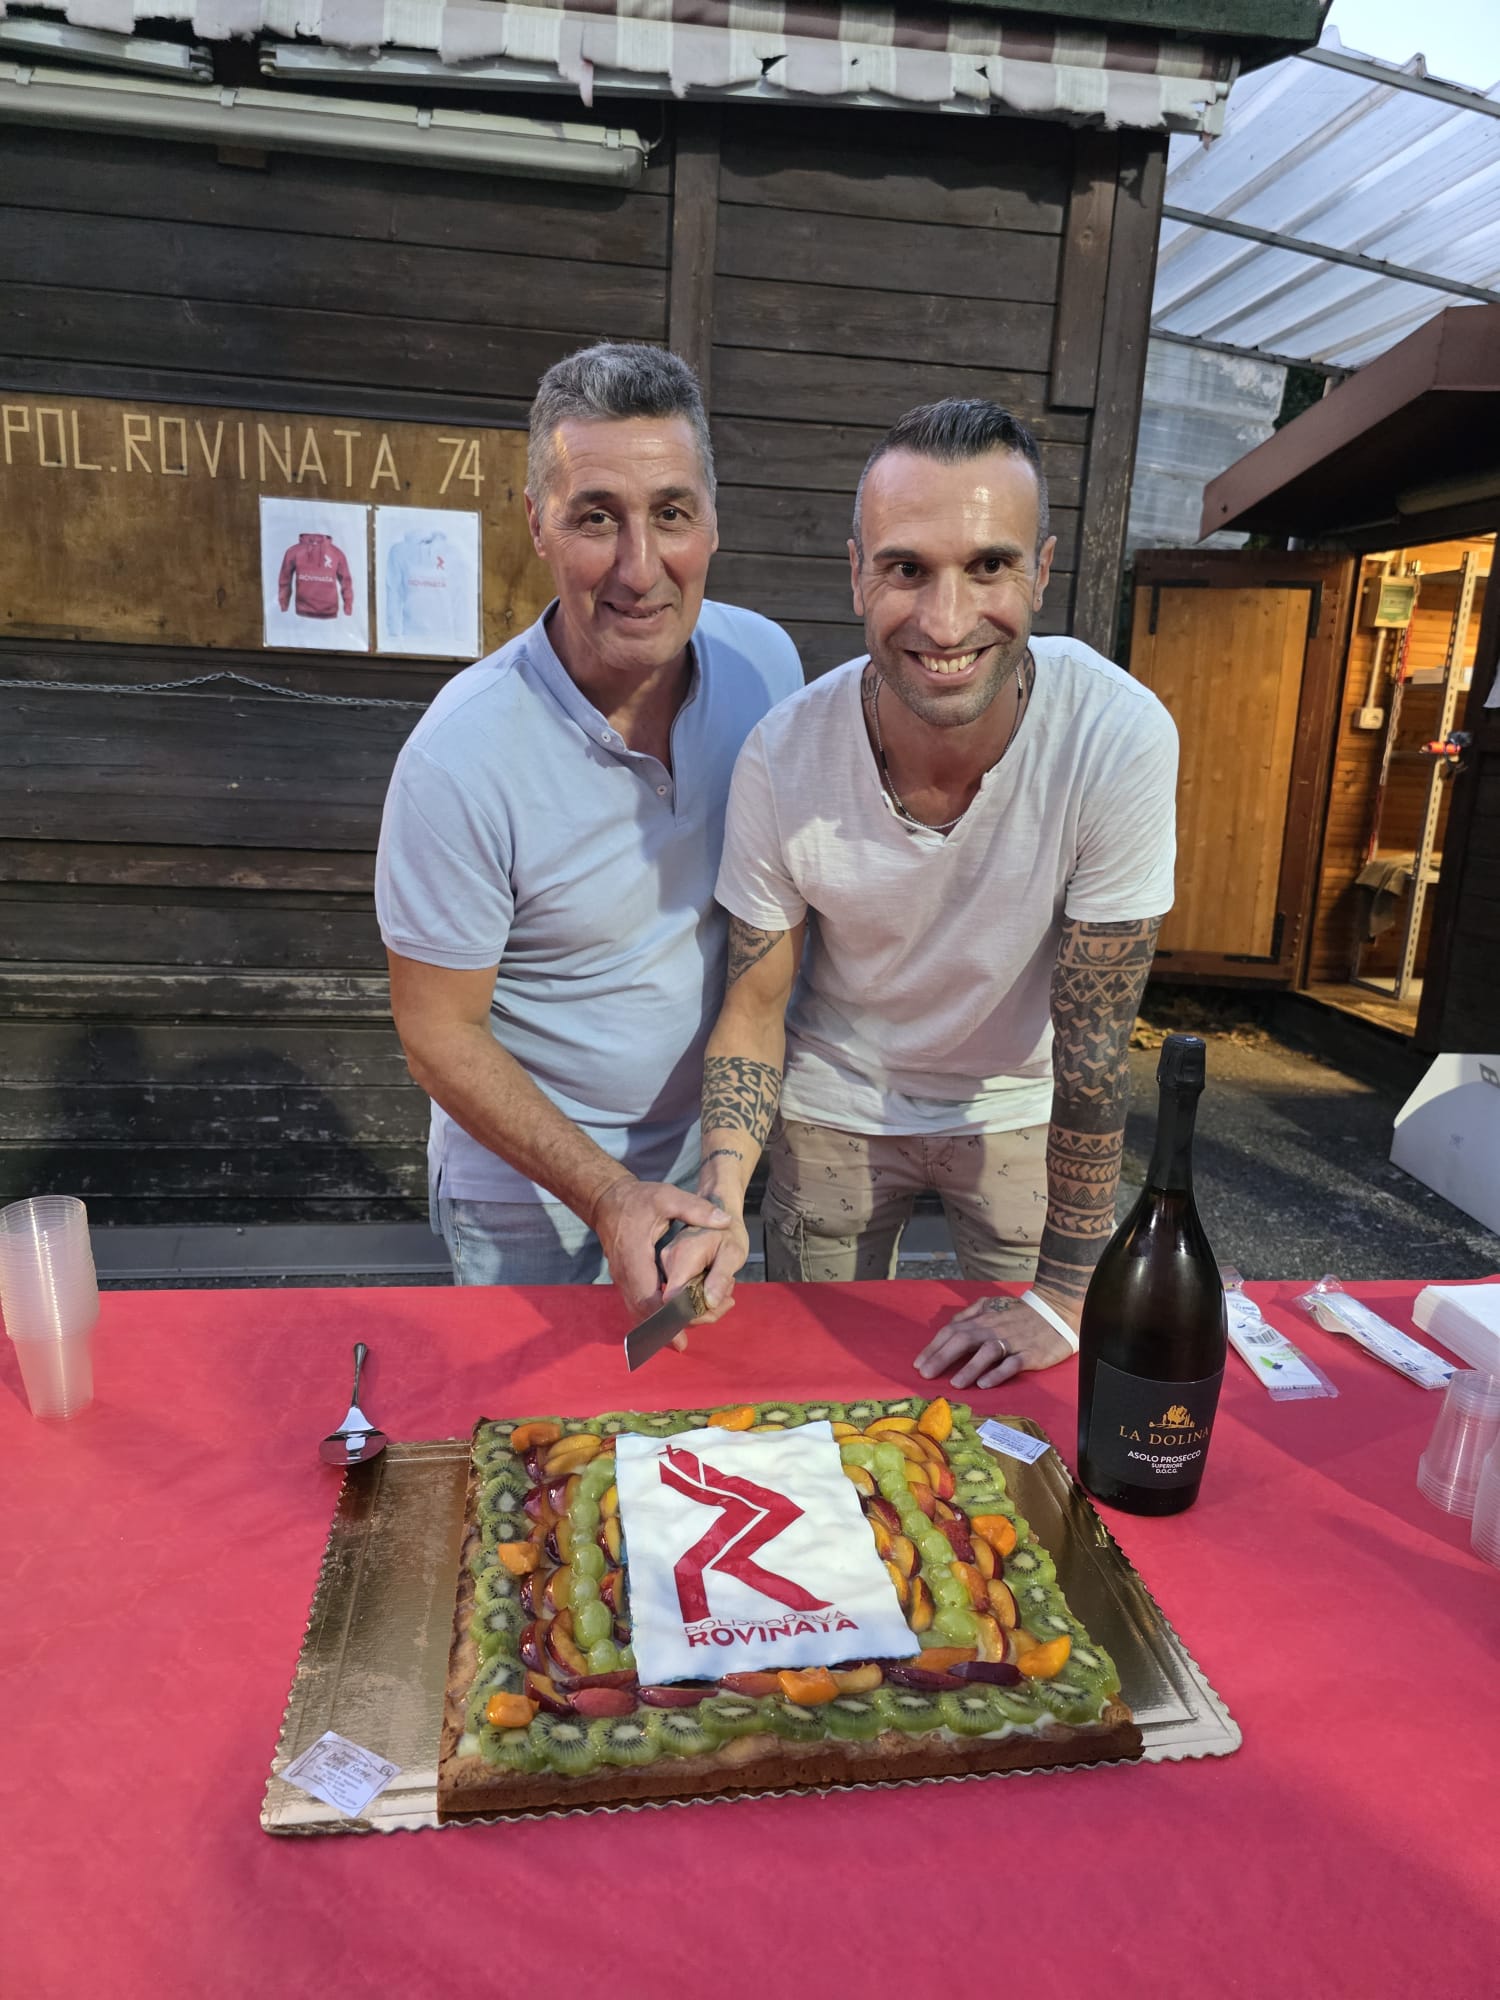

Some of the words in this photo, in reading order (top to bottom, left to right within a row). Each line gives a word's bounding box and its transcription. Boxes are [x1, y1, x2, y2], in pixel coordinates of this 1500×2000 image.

[438, 437, 485, 496] 74
[1119, 1425, 1141, 1442] LA
[1149, 1427, 1209, 1446] DOLINA
[1127, 1450, 1159, 1463] ASOLO
[1160, 1449, 1201, 1463] PROSECCO
[687, 1617, 860, 1648] ROVINATA
